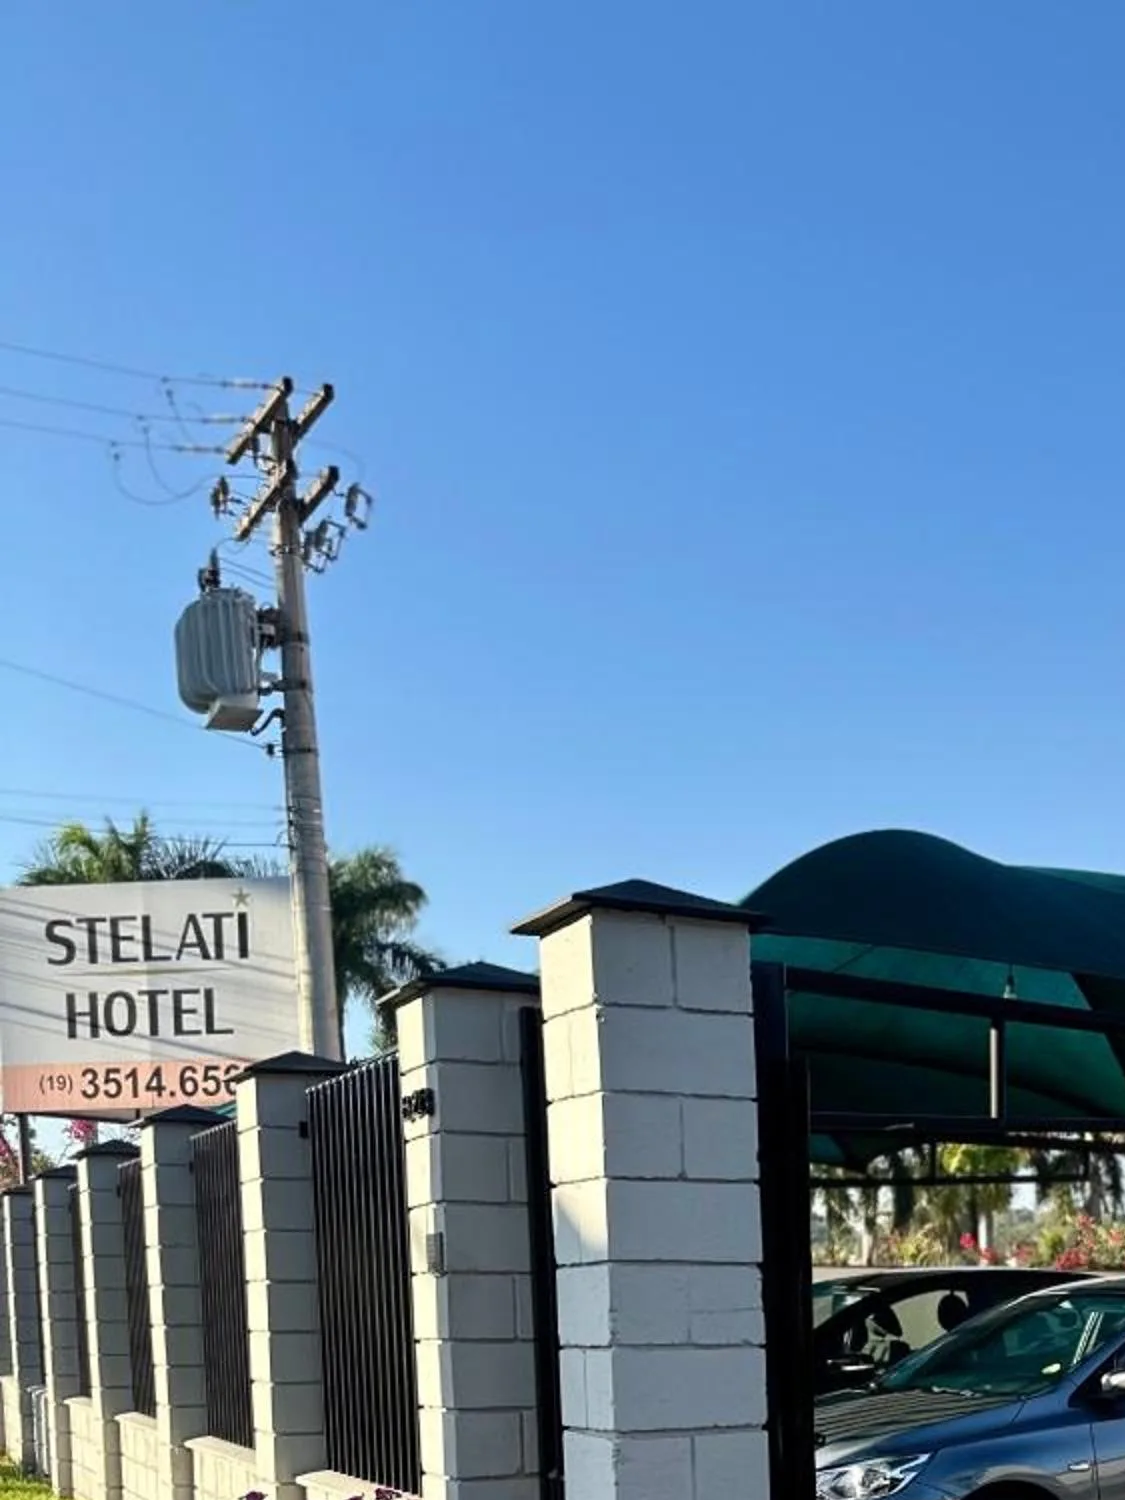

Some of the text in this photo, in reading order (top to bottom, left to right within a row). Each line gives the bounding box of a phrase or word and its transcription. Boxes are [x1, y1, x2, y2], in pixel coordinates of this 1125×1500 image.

[45, 911, 249, 966] STELATI
[66, 987, 234, 1039] HOTEL
[39, 1075, 73, 1095] (19)
